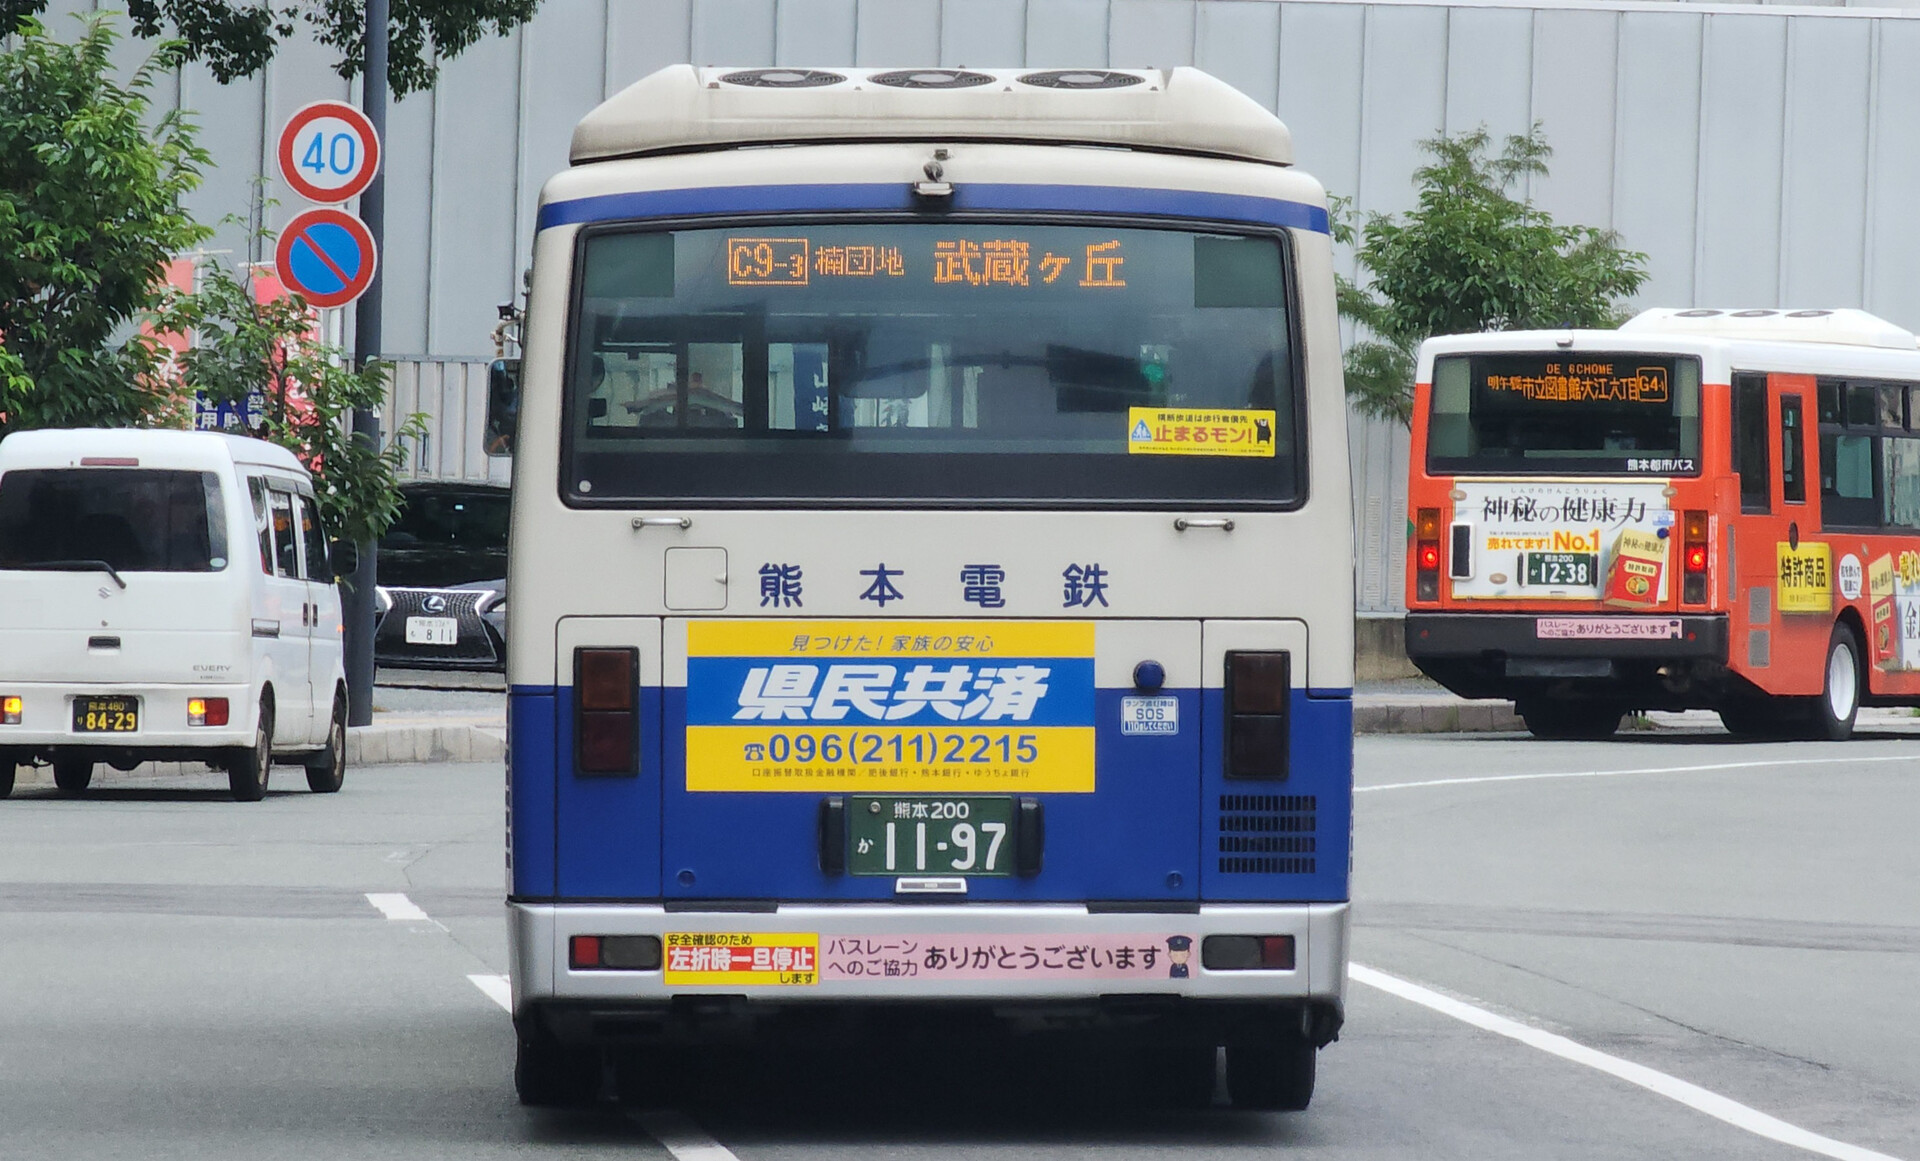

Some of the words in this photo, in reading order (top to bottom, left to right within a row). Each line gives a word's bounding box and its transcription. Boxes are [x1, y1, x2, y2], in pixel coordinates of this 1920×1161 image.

[302, 132, 355, 175] 40
[734, 243, 803, 277] C9-3
[815, 246, 904, 276] 楠団地
[1546, 364, 1561, 374] OE
[1154, 425, 1252, 444] 止まるモン!
[1627, 458, 1694, 471] 熊本都市バス
[1483, 496, 1647, 531] 神秘の健康力
[1487, 537, 1550, 550] 売れてます!
[1553, 530, 1600, 551] No.1
[1781, 555, 1826, 588] 特許商品
[758, 562, 1109, 608] 熊本電鉄
[1576, 624, 1668, 635] ありがとうございます
[732, 664, 1051, 721] 県民共済
[86, 712, 135, 730] 84-29
[1136, 708, 1164, 720] SOS
[768, 732, 1038, 765] 096(211)2215
[857, 838, 874, 854] か
[886, 822, 1007, 871] 11-97
[668, 934, 752, 946] 安全確認のため
[828, 938, 918, 955] バスレーン
[669, 947, 814, 972] 左折時一旦停止
[828, 959, 918, 977] へのご協力
[923, 945, 1162, 970] ありがとうございます
[779, 973, 815, 984] します
